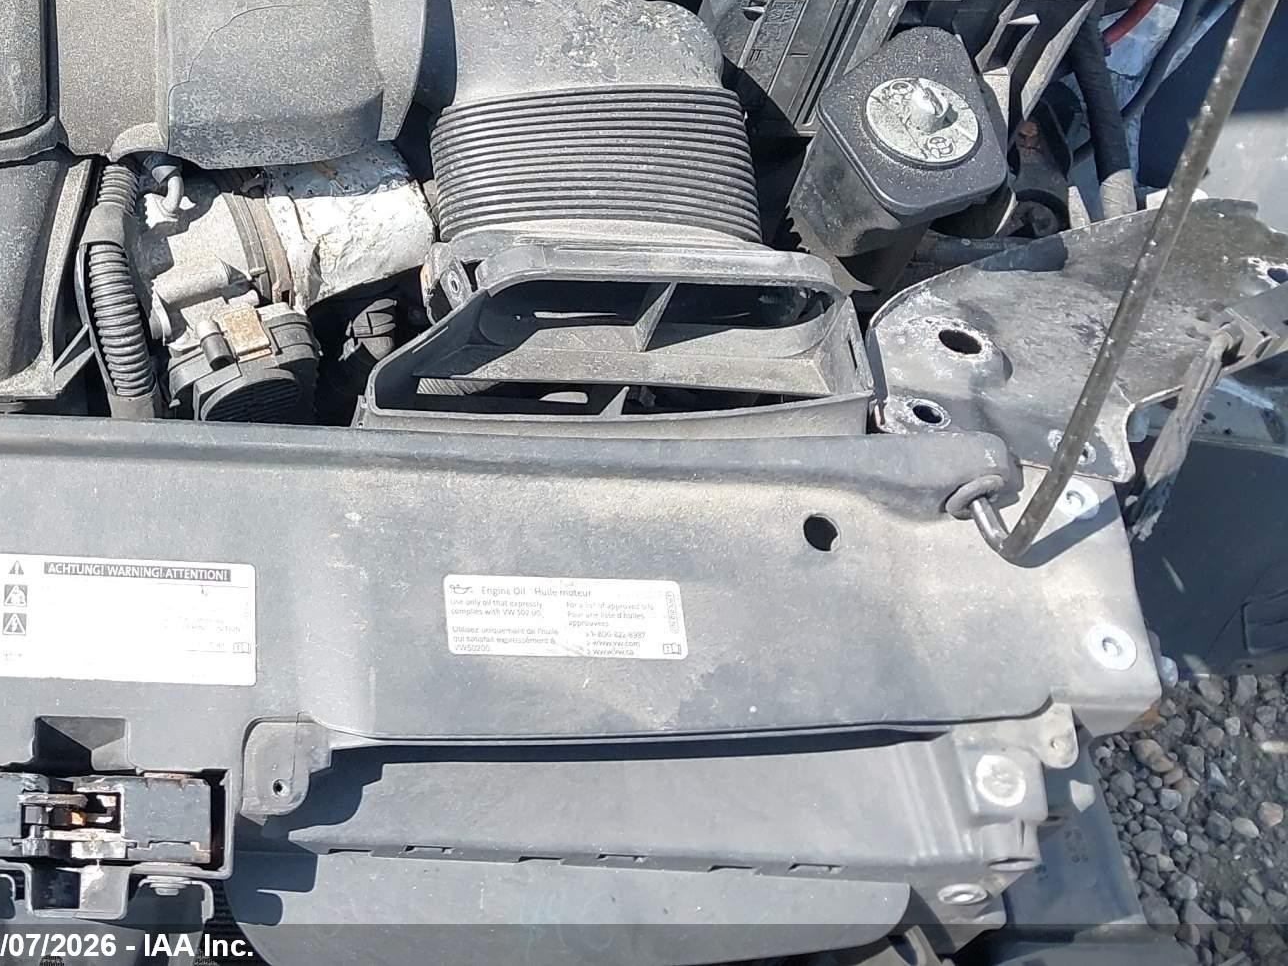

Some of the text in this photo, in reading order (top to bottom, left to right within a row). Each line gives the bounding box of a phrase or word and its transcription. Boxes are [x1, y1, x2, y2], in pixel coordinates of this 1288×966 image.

[47, 562, 229, 581] ACHTUNG! WARNING! ATTENTION!
[513, 586, 526, 595] Oil
[534, 586, 558, 596] Huile
[559, 588, 591, 598] moteur
